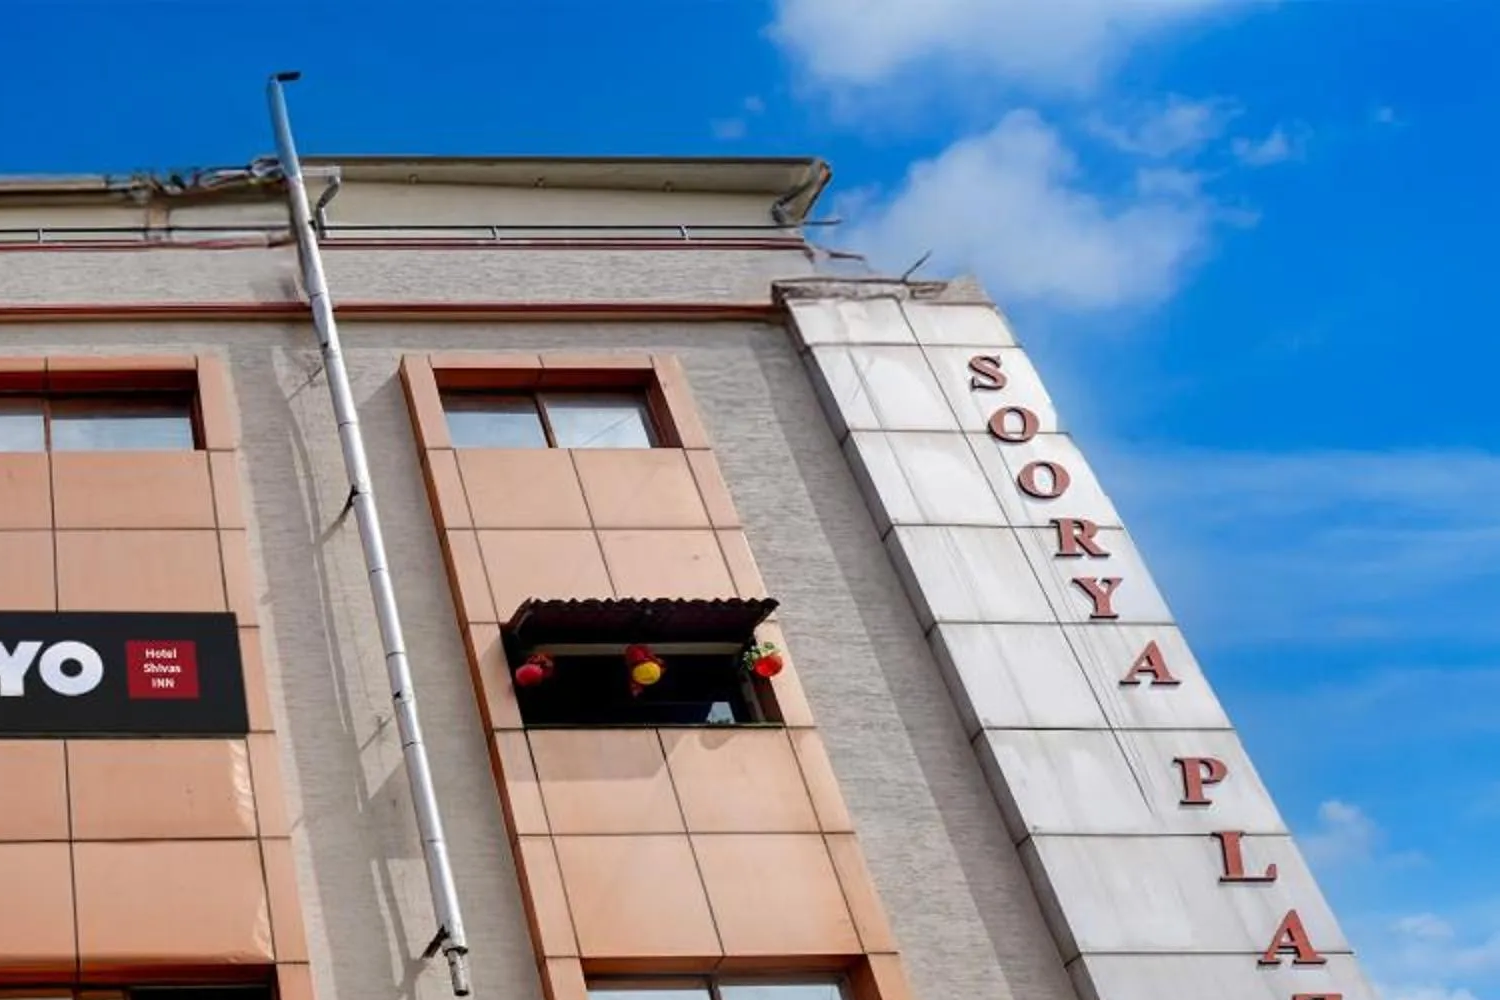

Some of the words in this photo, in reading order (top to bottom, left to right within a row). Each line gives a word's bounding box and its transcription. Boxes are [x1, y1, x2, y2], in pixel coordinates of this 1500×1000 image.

[967, 354, 1181, 686] SOORYA
[145, 648, 177, 659] Hotel
[143, 662, 181, 673] Shivas
[151, 677, 175, 689] INN
